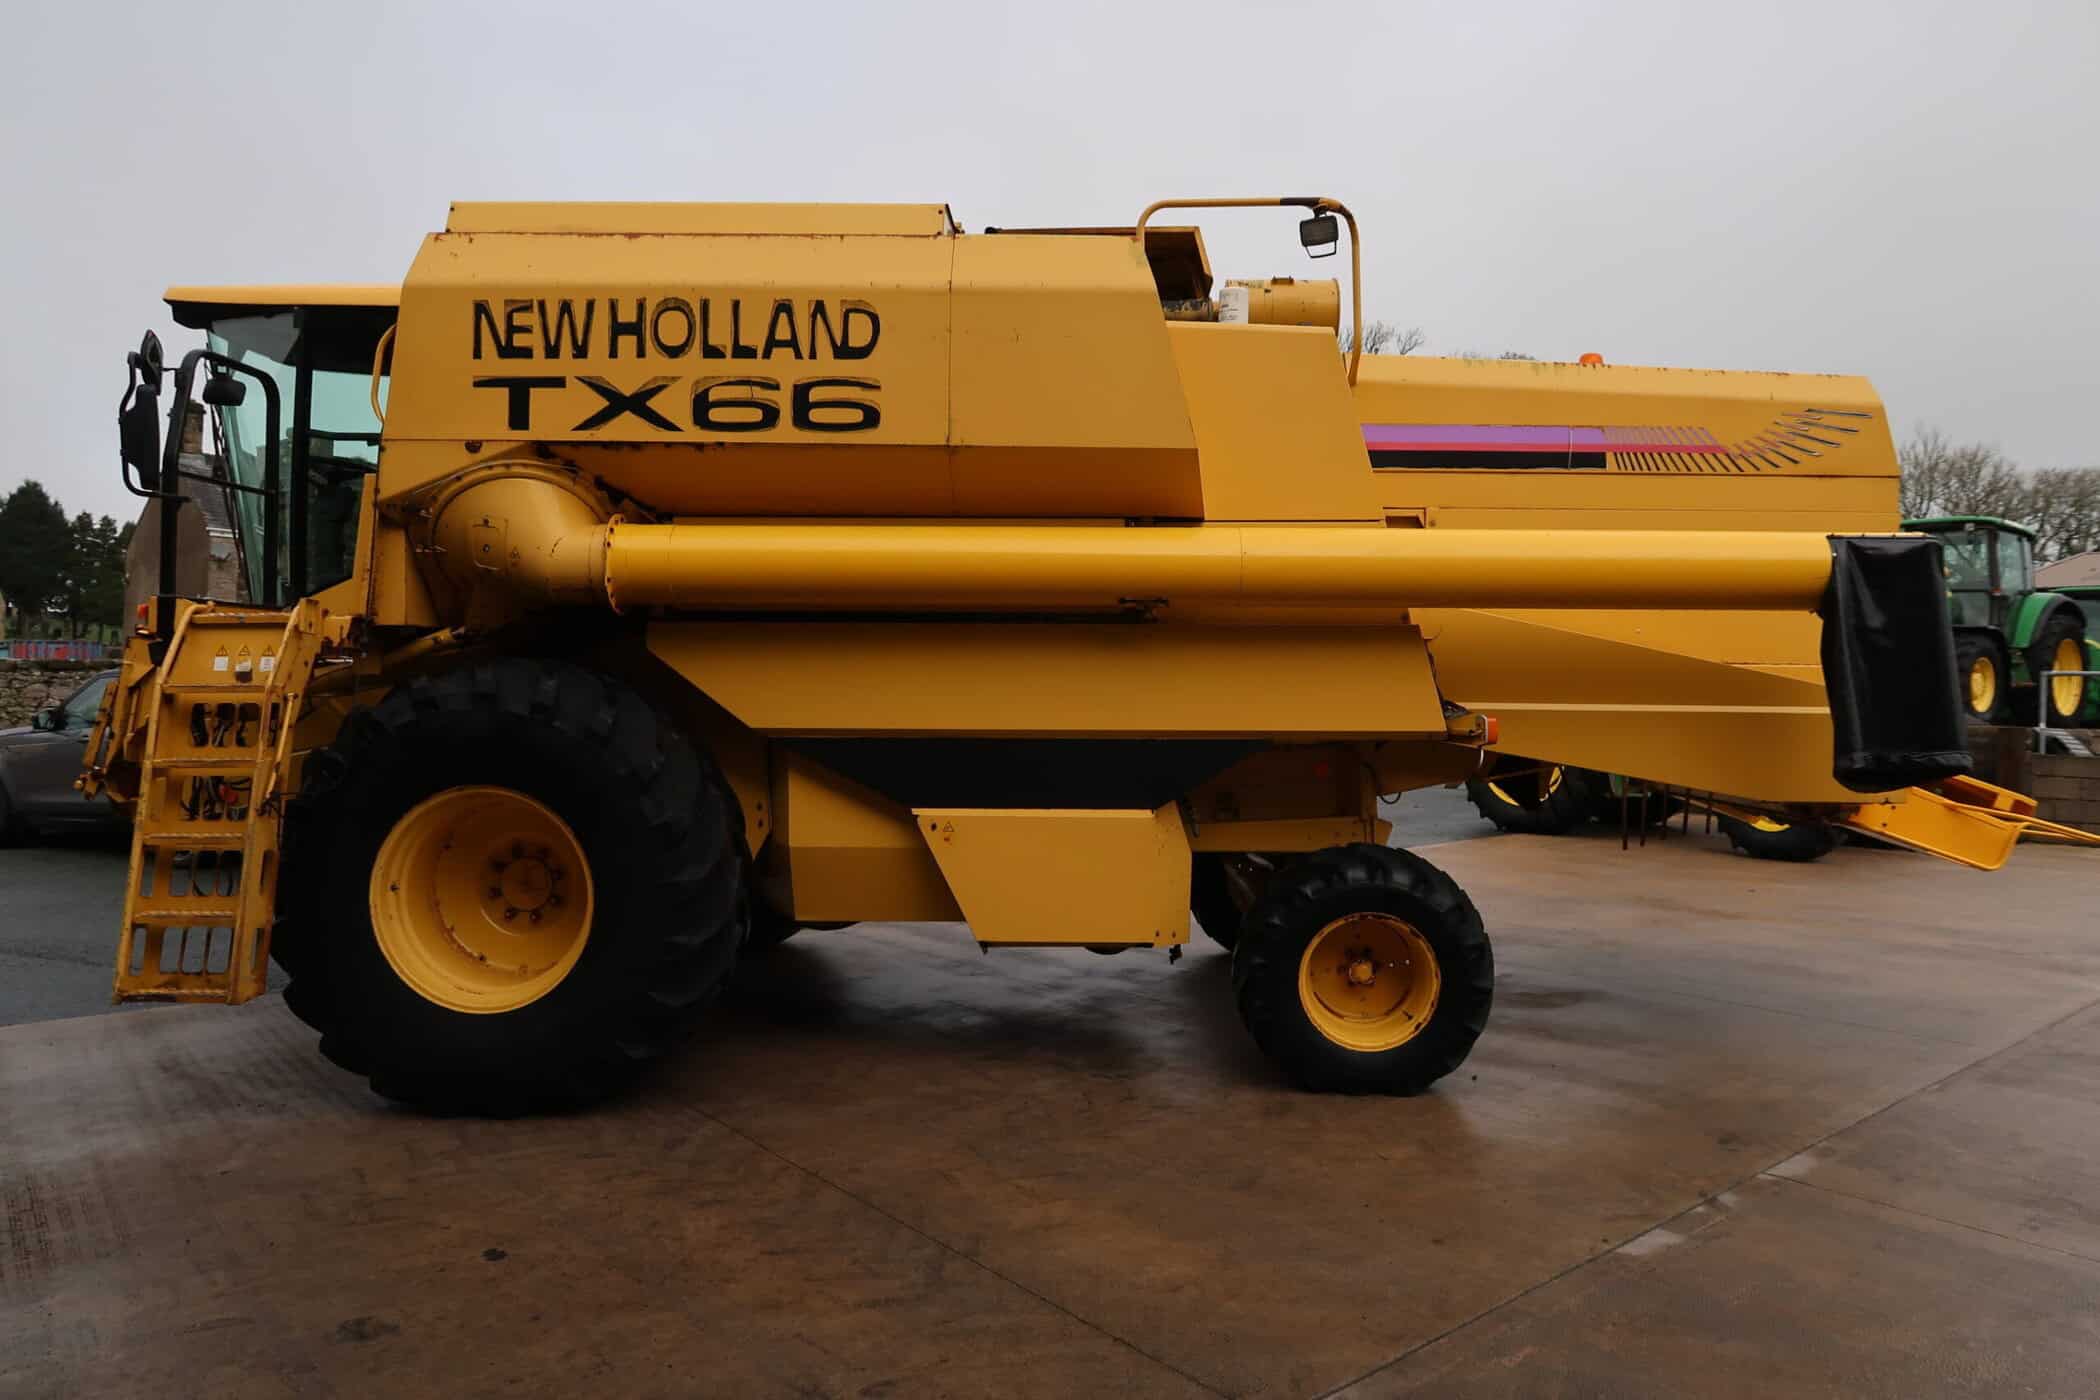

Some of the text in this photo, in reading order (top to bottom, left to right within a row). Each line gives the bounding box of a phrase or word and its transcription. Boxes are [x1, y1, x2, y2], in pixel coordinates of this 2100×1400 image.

[472, 297, 881, 360] NEW HOLLAND
[472, 376, 882, 432] TX66
